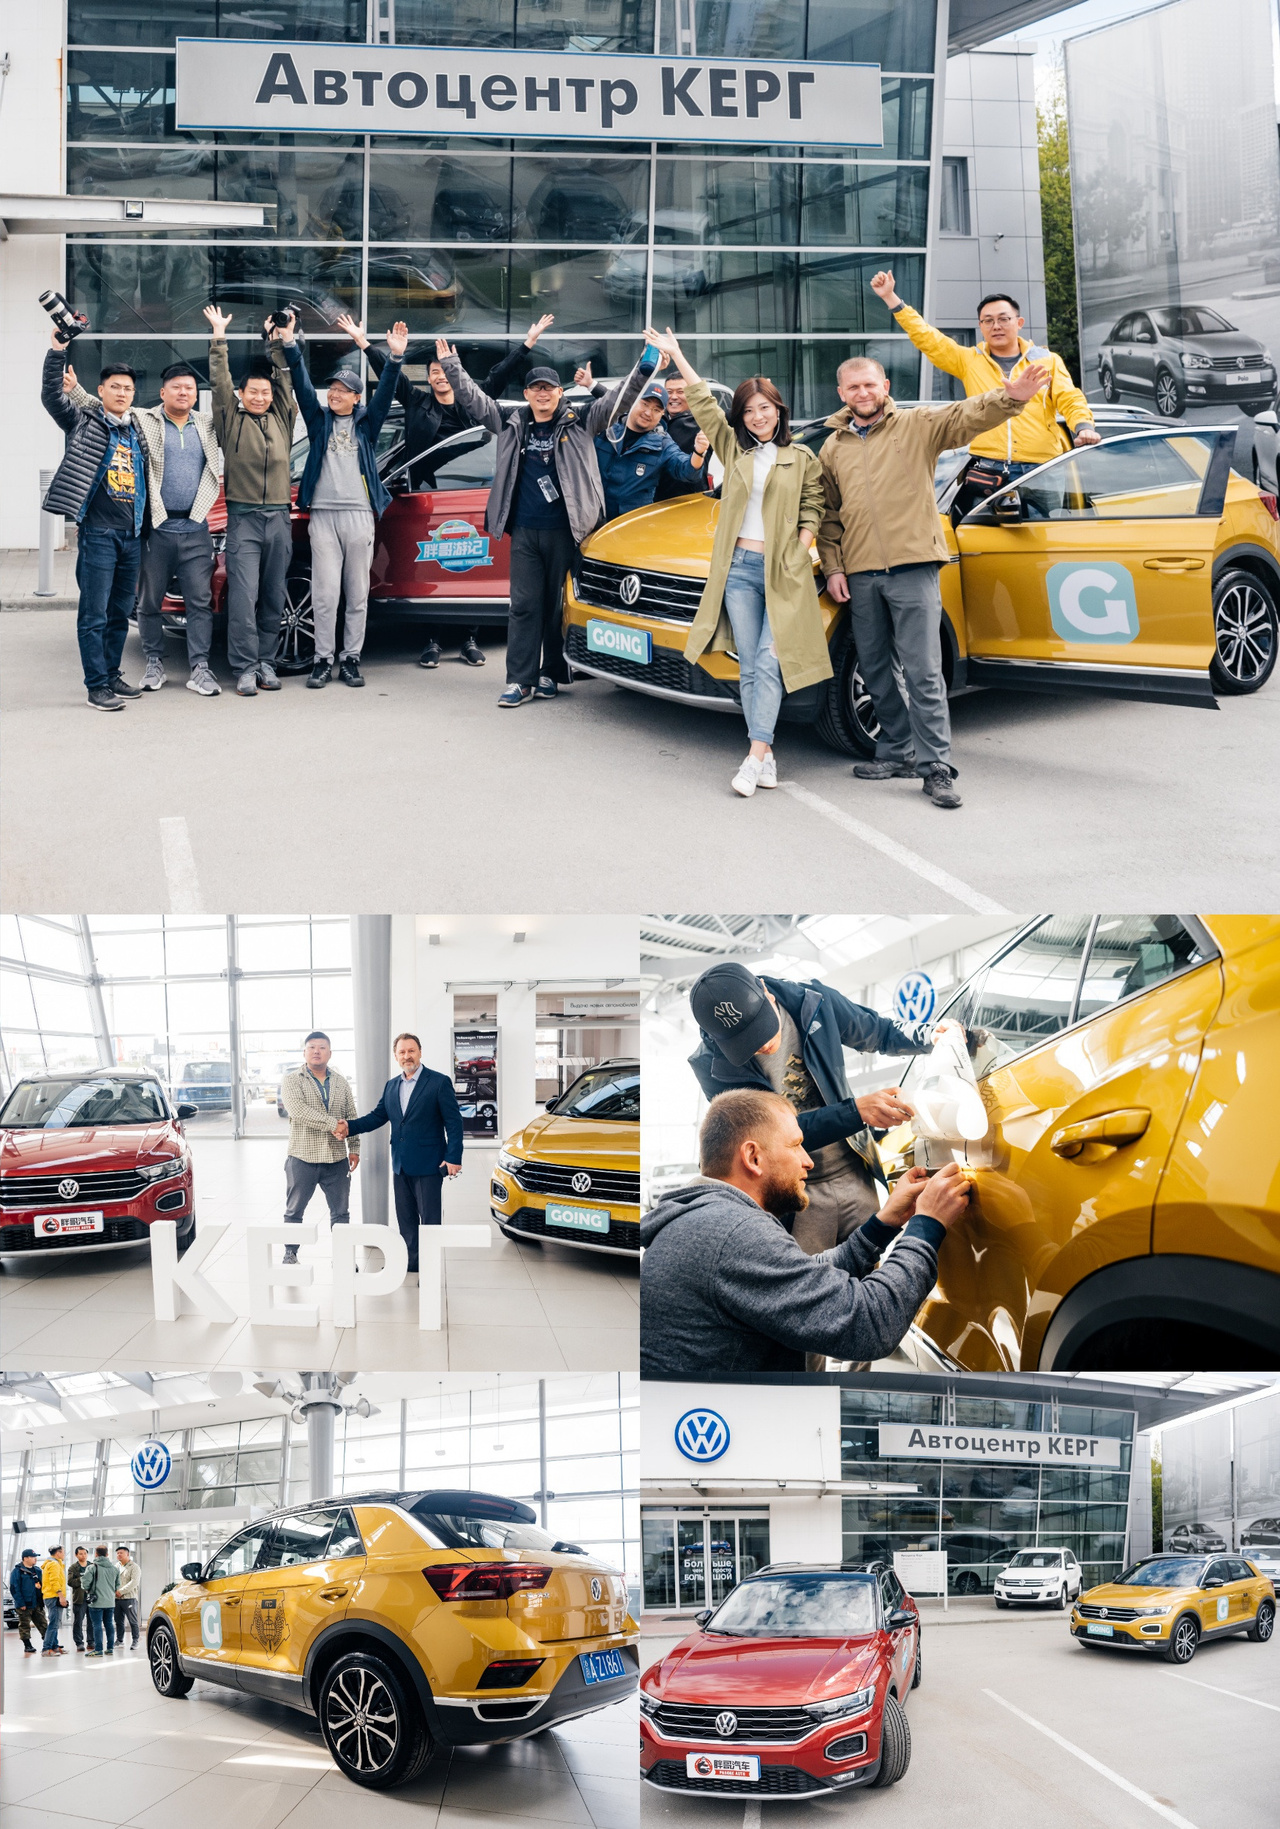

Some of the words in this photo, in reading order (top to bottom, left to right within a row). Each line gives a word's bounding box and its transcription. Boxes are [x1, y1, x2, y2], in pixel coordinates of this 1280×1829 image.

[255, 52, 639, 129] Автоцентр
[660, 66, 817, 120] КЕРГ
[423, 540, 483, 558] 胖哥游记
[1058, 569, 1131, 635] G
[150, 1220, 492, 1331] КЕРГ
[907, 1428, 1041, 1458] Автоцентр
[1048, 1437, 1099, 1457] КЕРГ
[203, 1604, 220, 1643] G
